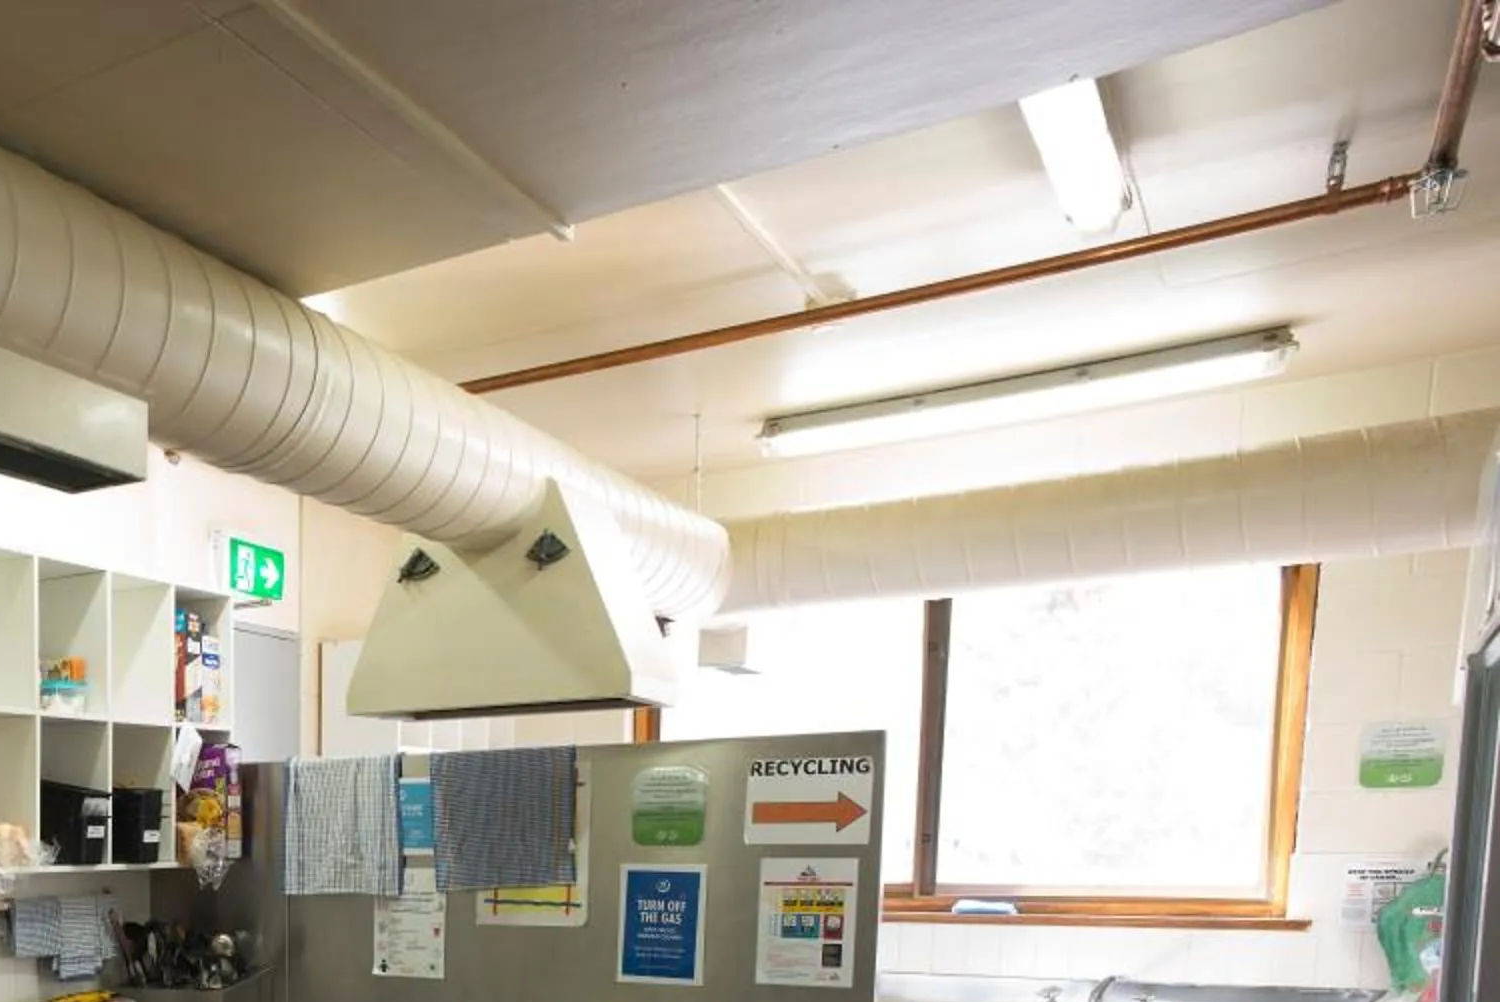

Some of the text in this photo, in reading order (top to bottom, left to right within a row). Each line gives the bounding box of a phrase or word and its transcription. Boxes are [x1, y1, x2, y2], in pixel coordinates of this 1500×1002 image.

[751, 758, 871, 777] RECYCLING
[637, 899, 687, 912] TURN OFF
[639, 911, 683, 925] THE GAS
